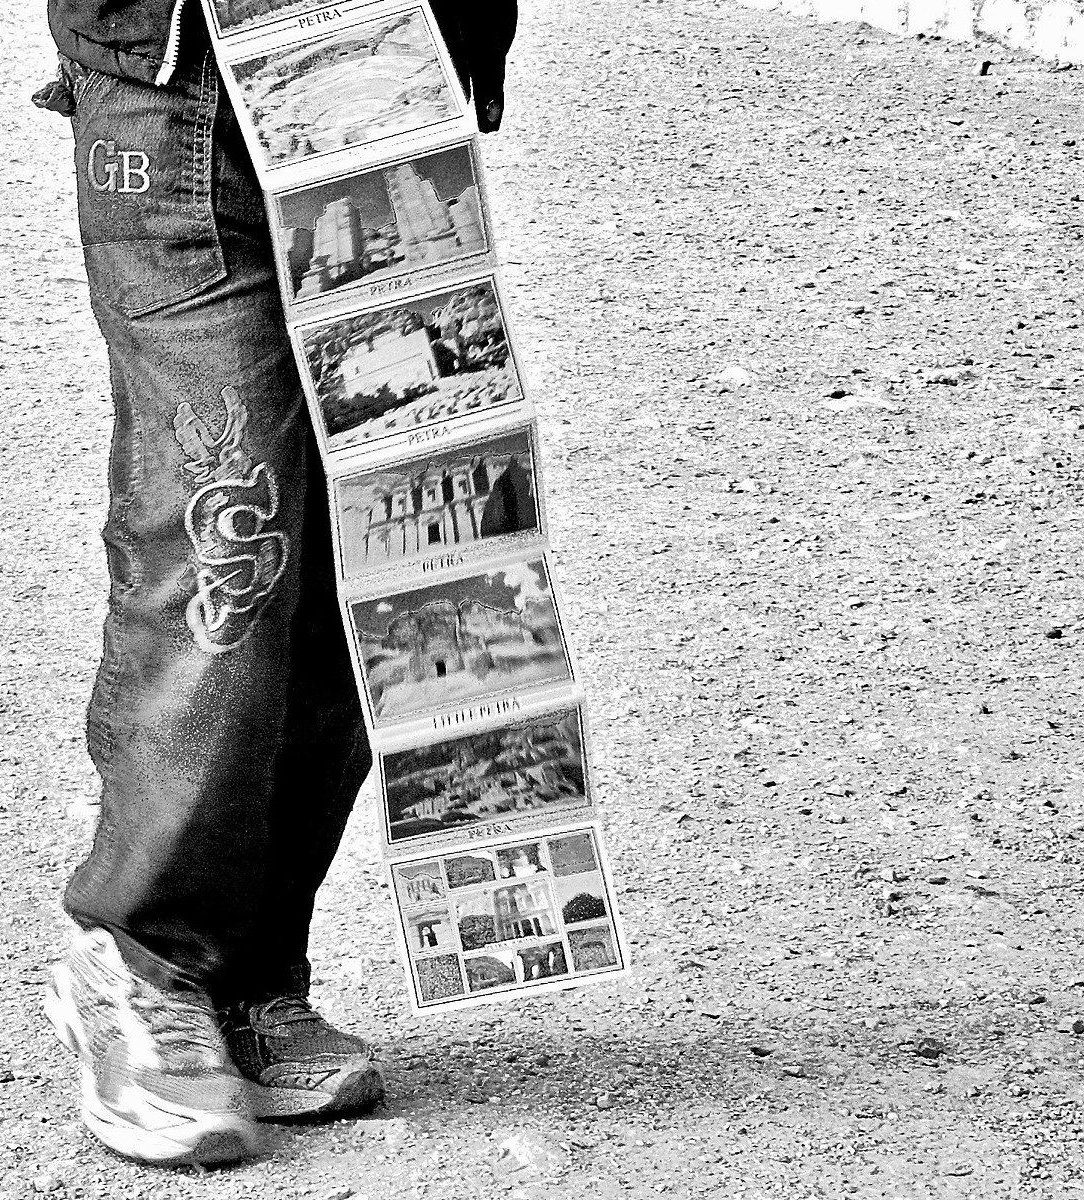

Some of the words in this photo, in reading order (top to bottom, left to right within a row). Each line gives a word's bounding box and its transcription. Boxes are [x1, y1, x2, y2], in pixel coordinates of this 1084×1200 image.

[298, 8, 342, 29] PETRA
[87, 138, 151, 194] GB
[407, 425, 451, 446] PETRA
